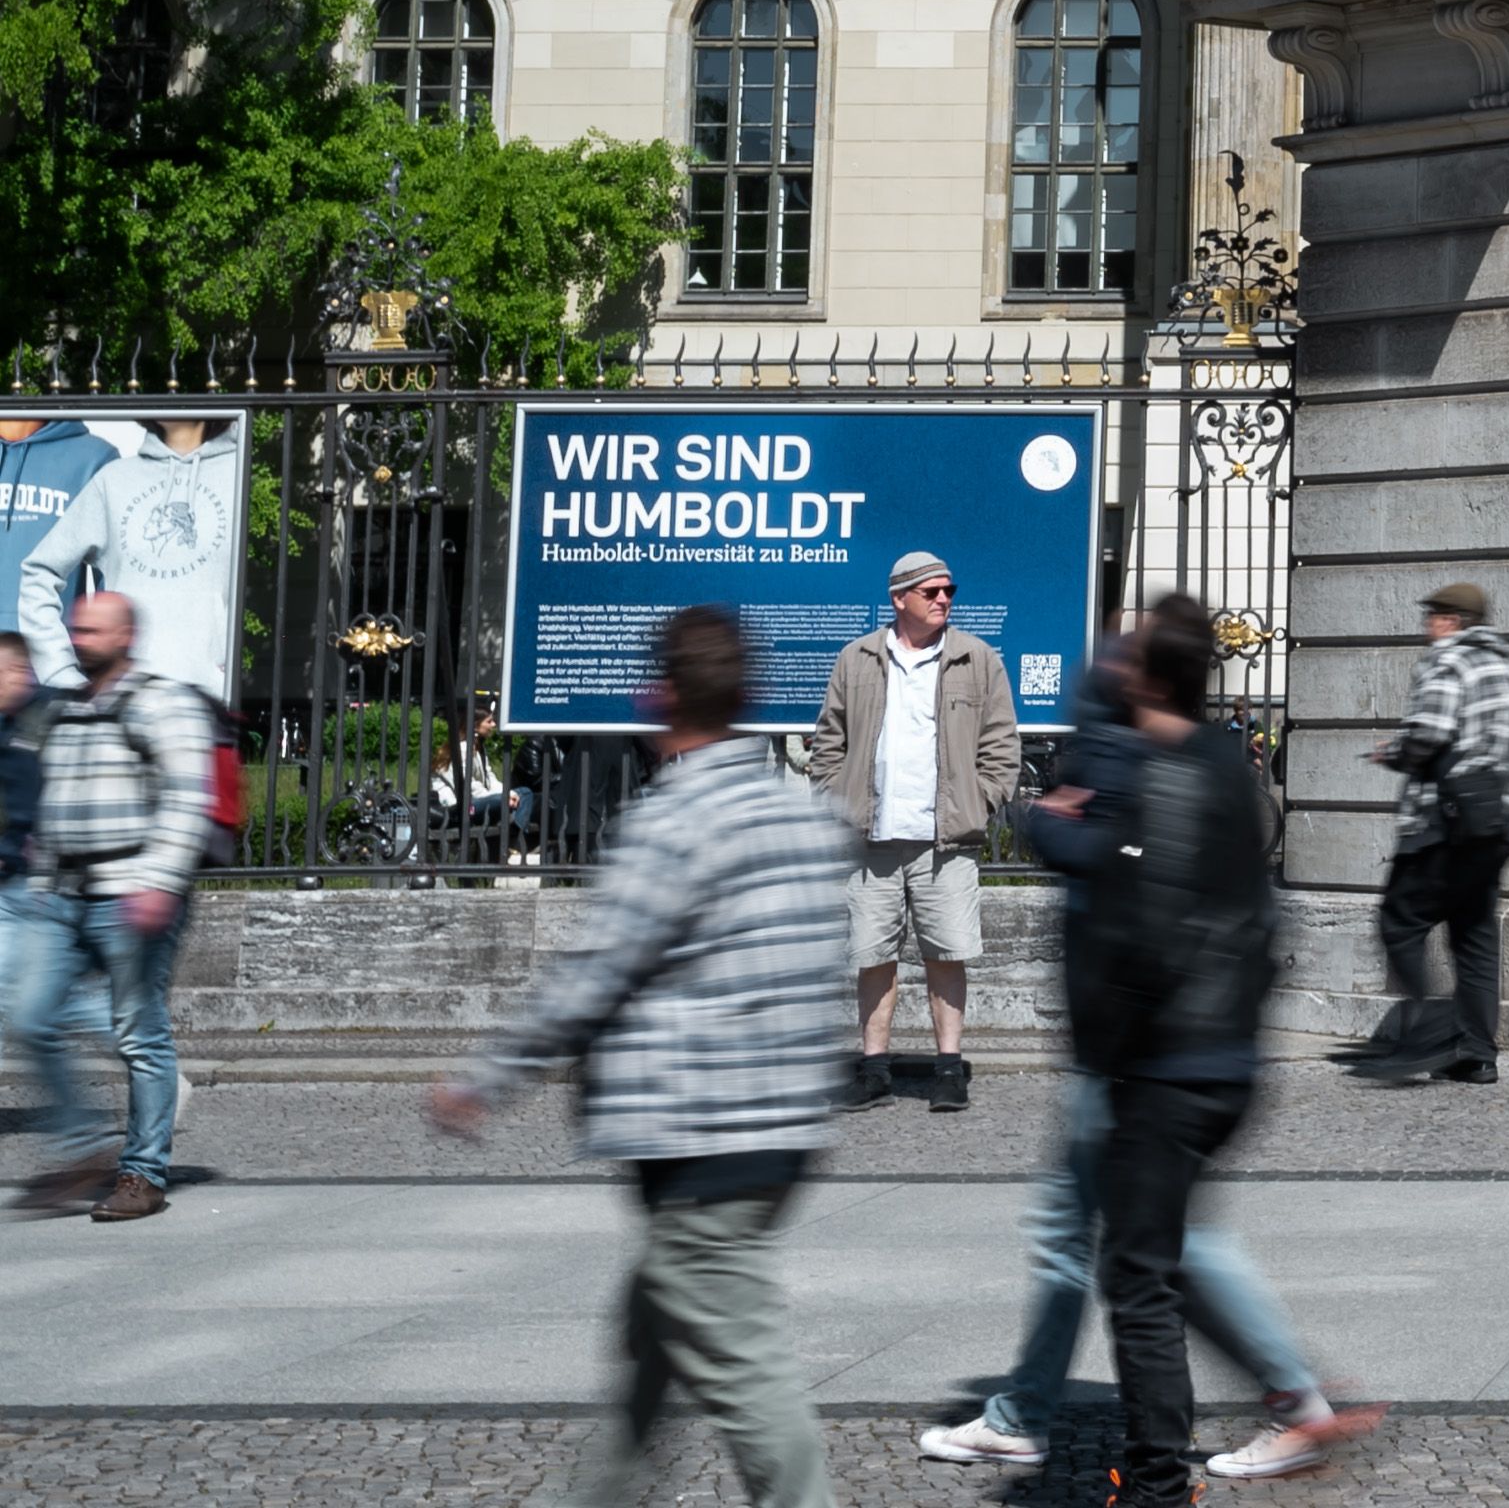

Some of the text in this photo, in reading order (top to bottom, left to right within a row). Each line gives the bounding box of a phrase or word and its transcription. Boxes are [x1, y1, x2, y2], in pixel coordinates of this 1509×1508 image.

[548, 435, 811, 481] WIR SIND
[542, 492, 865, 538] HUMBOLDT
[542, 543, 848, 563] Humboldt-Universität zu Berlin
[538, 604, 551, 613] Wir
[552, 604, 567, 613] sind
[606, 604, 618, 613] Wir
[654, 604, 676, 613] lehren
[538, 614, 621, 622] arbeiten für und mit der
[607, 633, 620, 642] und
[537, 643, 551, 651] und
[537, 658, 548, 666] We
[550, 658, 561, 666] are
[536, 667, 555, 676] work
[556, 667, 565, 676] for
[567, 667, 581, 676] and
[582, 667, 597, 676] with
[535, 687, 549, 695] and
